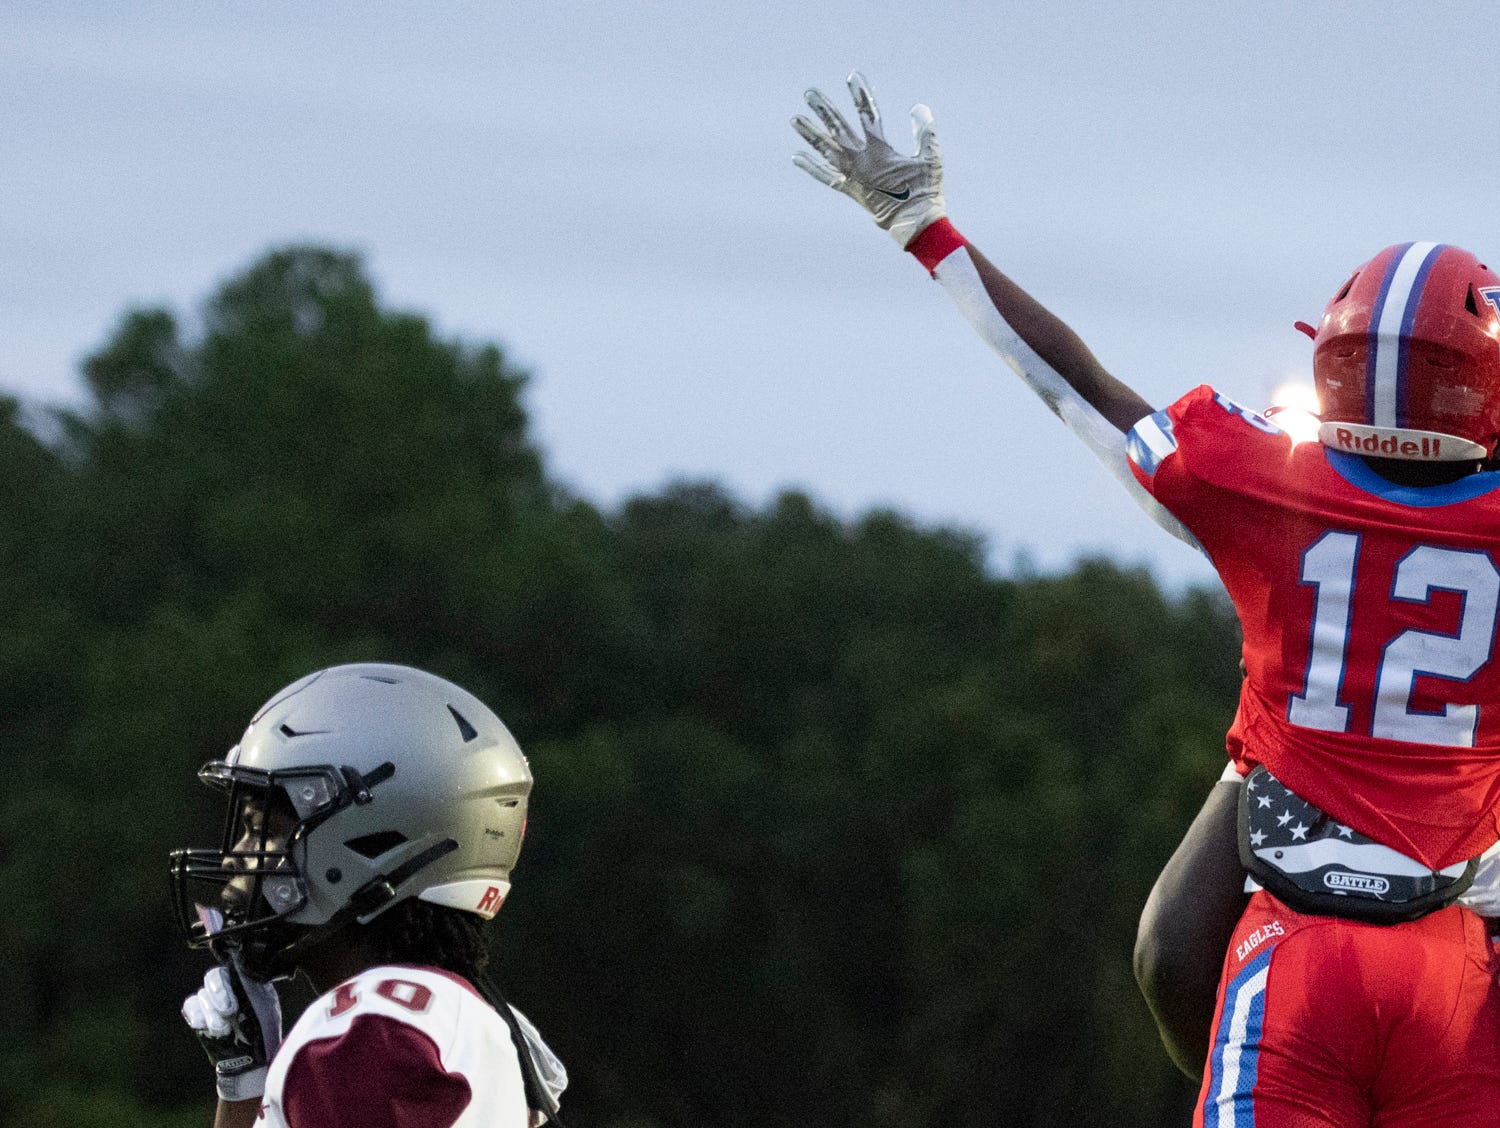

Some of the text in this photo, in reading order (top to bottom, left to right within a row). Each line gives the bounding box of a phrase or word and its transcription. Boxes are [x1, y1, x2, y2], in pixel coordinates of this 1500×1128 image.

[1335, 427, 1441, 458] Riddell
[1330, 874, 1384, 891] BATTLE
[1235, 920, 1285, 963] EAGLES
[326, 979, 435, 1020] 10
